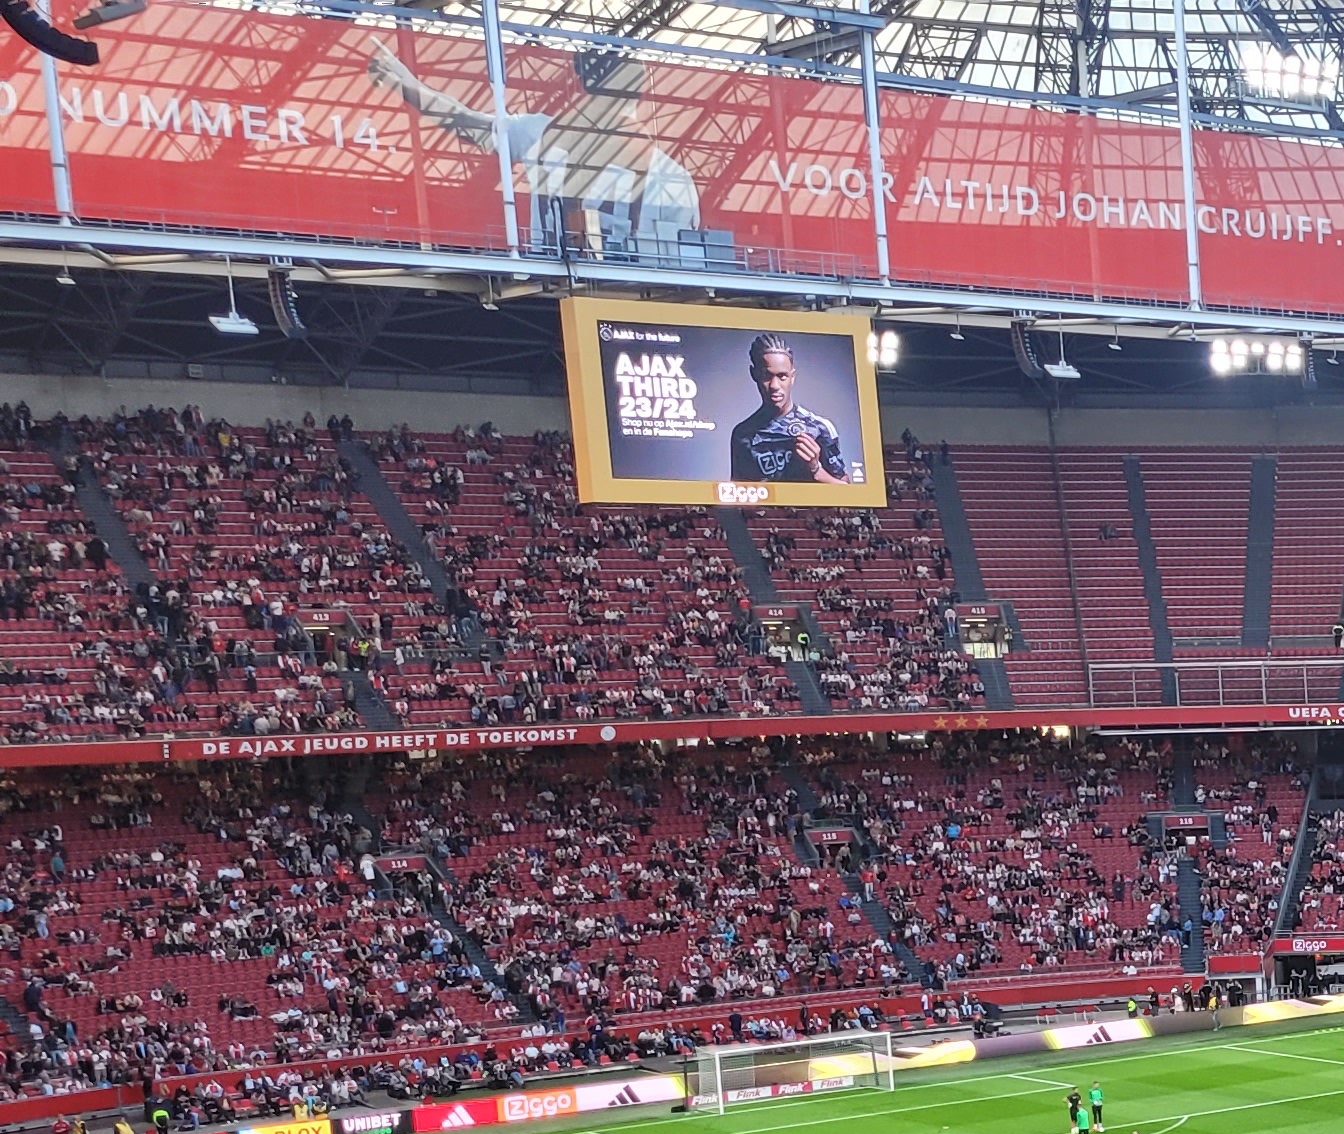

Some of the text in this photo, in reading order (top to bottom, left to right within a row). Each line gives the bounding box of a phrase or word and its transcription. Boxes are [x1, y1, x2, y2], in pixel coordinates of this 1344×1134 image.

[58, 86, 310, 145] NUMMER
[769, 160, 897, 203] VOOR
[914, 176, 1039, 216] ALTIJD
[1056, 190, 1183, 231] JOHAN
[616, 352, 687, 378] AJAX
[616, 375, 697, 399] THIRD
[619, 397, 697, 420] 23/24
[313, 613, 330, 622] 413
[768, 608, 783, 617] 414
[1288, 707, 1332, 718] UEFA
[203, 728, 578, 757] DE AJAX JEUGD HEEFT DE TOEKOMST
[391, 860, 408, 869] 114
[736, 1089, 761, 1099] Flink
[778, 1083, 805, 1095] Flink
[820, 1077, 844, 1088] Flink
[343, 1113, 402, 1132] UNIBET
